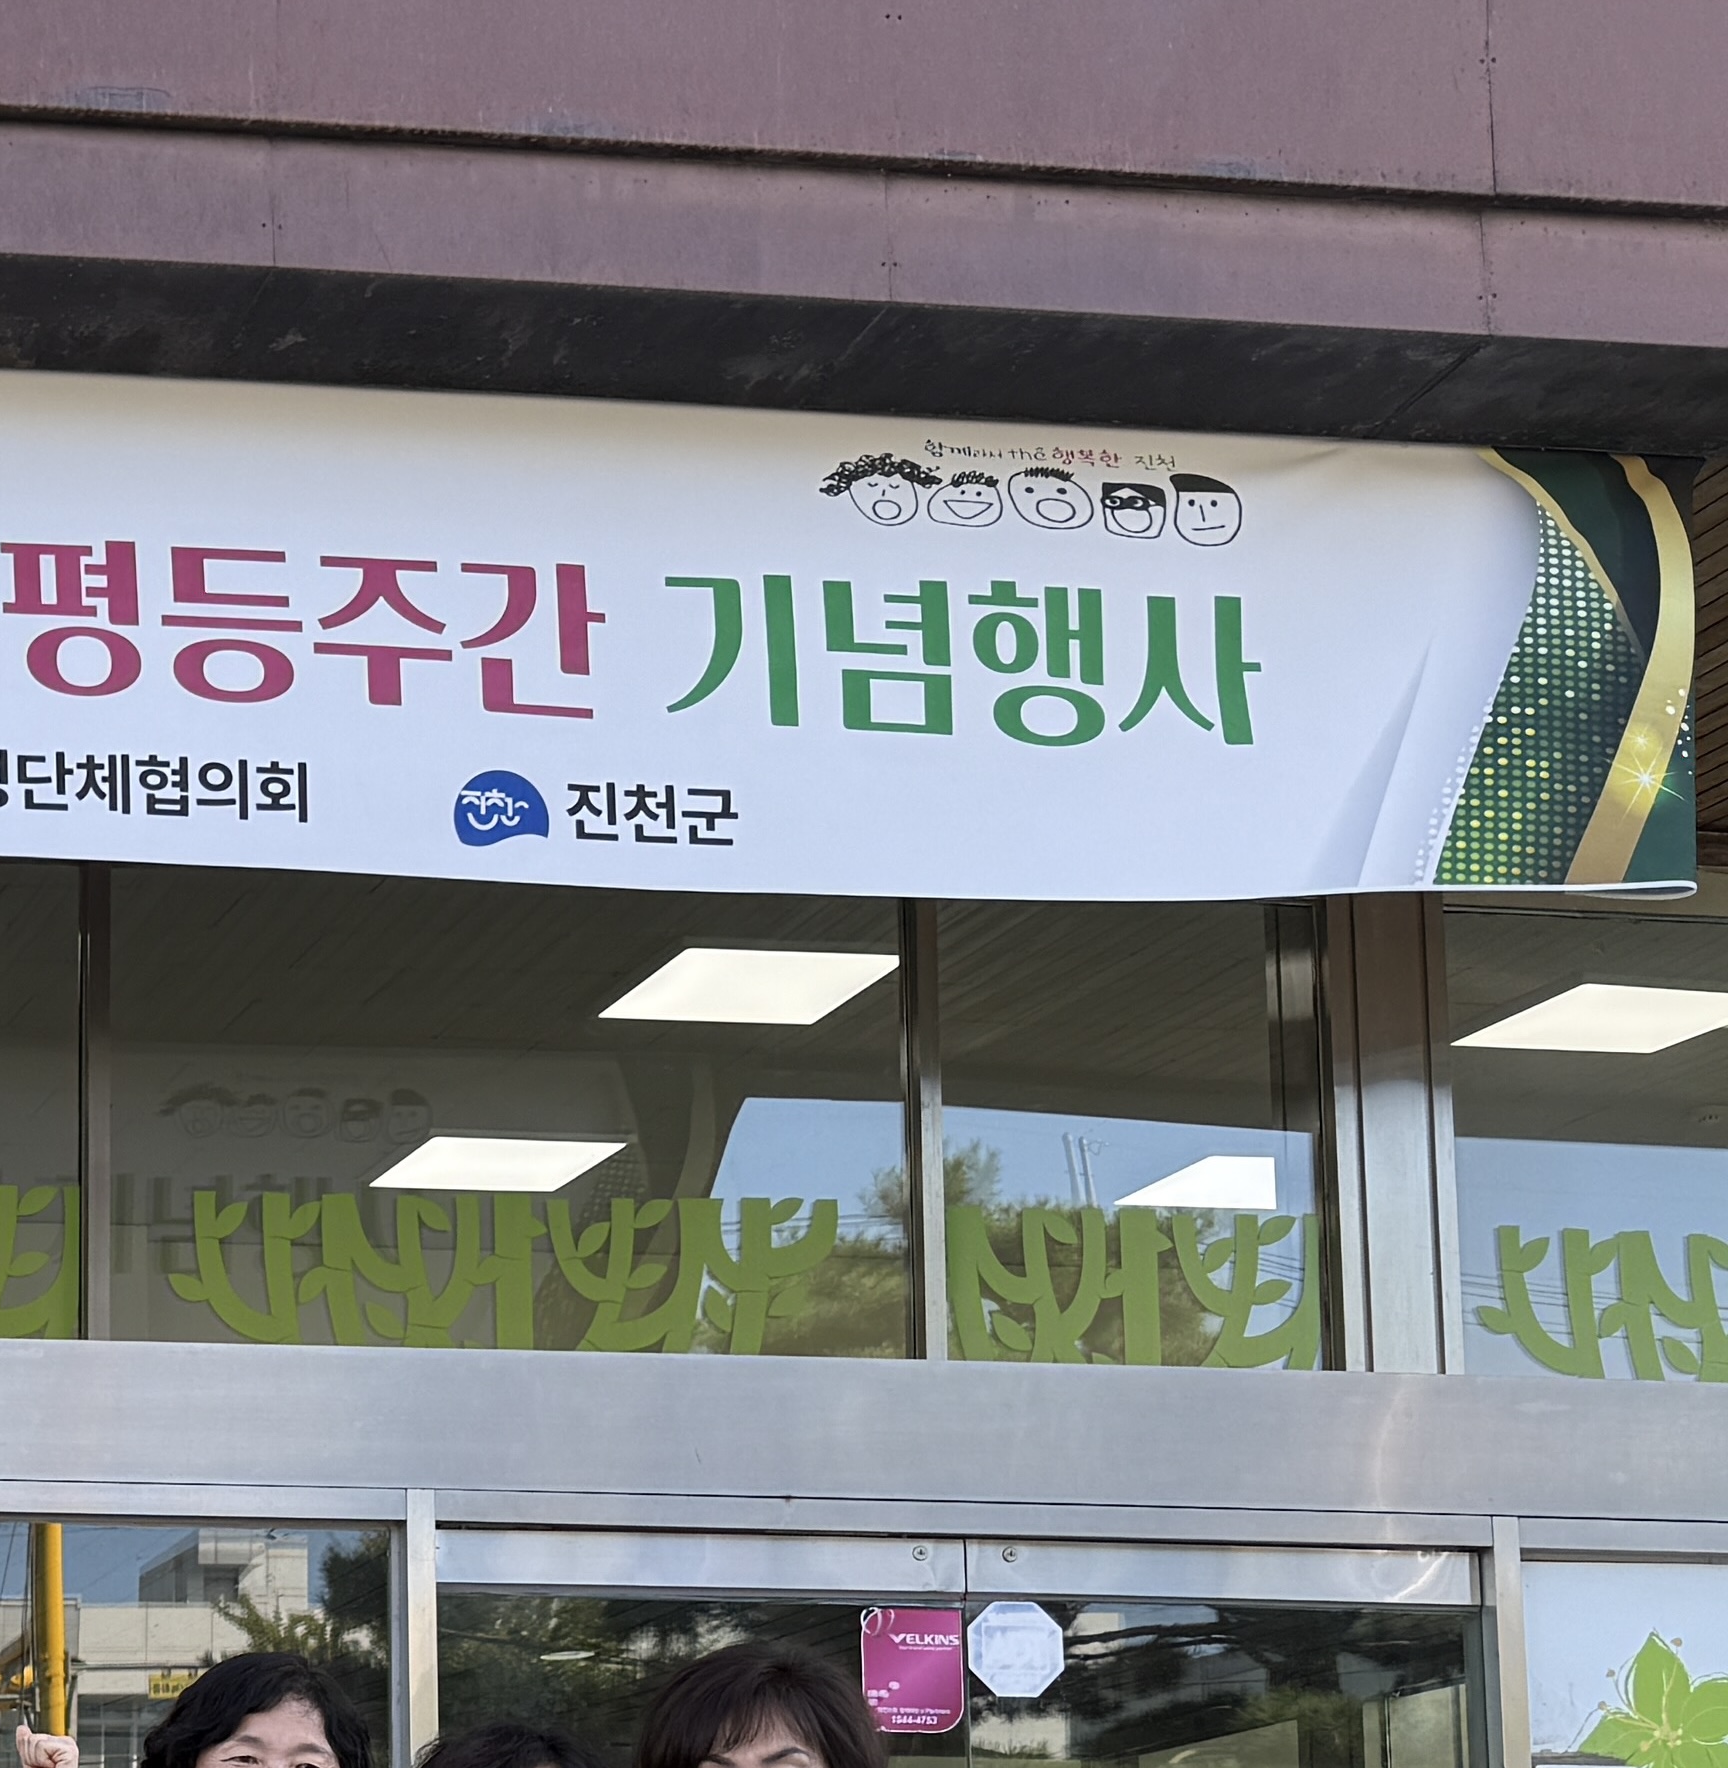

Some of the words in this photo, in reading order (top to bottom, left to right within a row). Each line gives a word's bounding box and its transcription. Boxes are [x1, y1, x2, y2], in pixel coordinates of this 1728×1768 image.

[1051, 448, 1121, 468] 행복한
[1134, 453, 1177, 471] 진천
[664, 573, 1262, 748] 기념행사
[565, 781, 740, 847] 진천군
[888, 1633, 960, 1645] VELKINS
